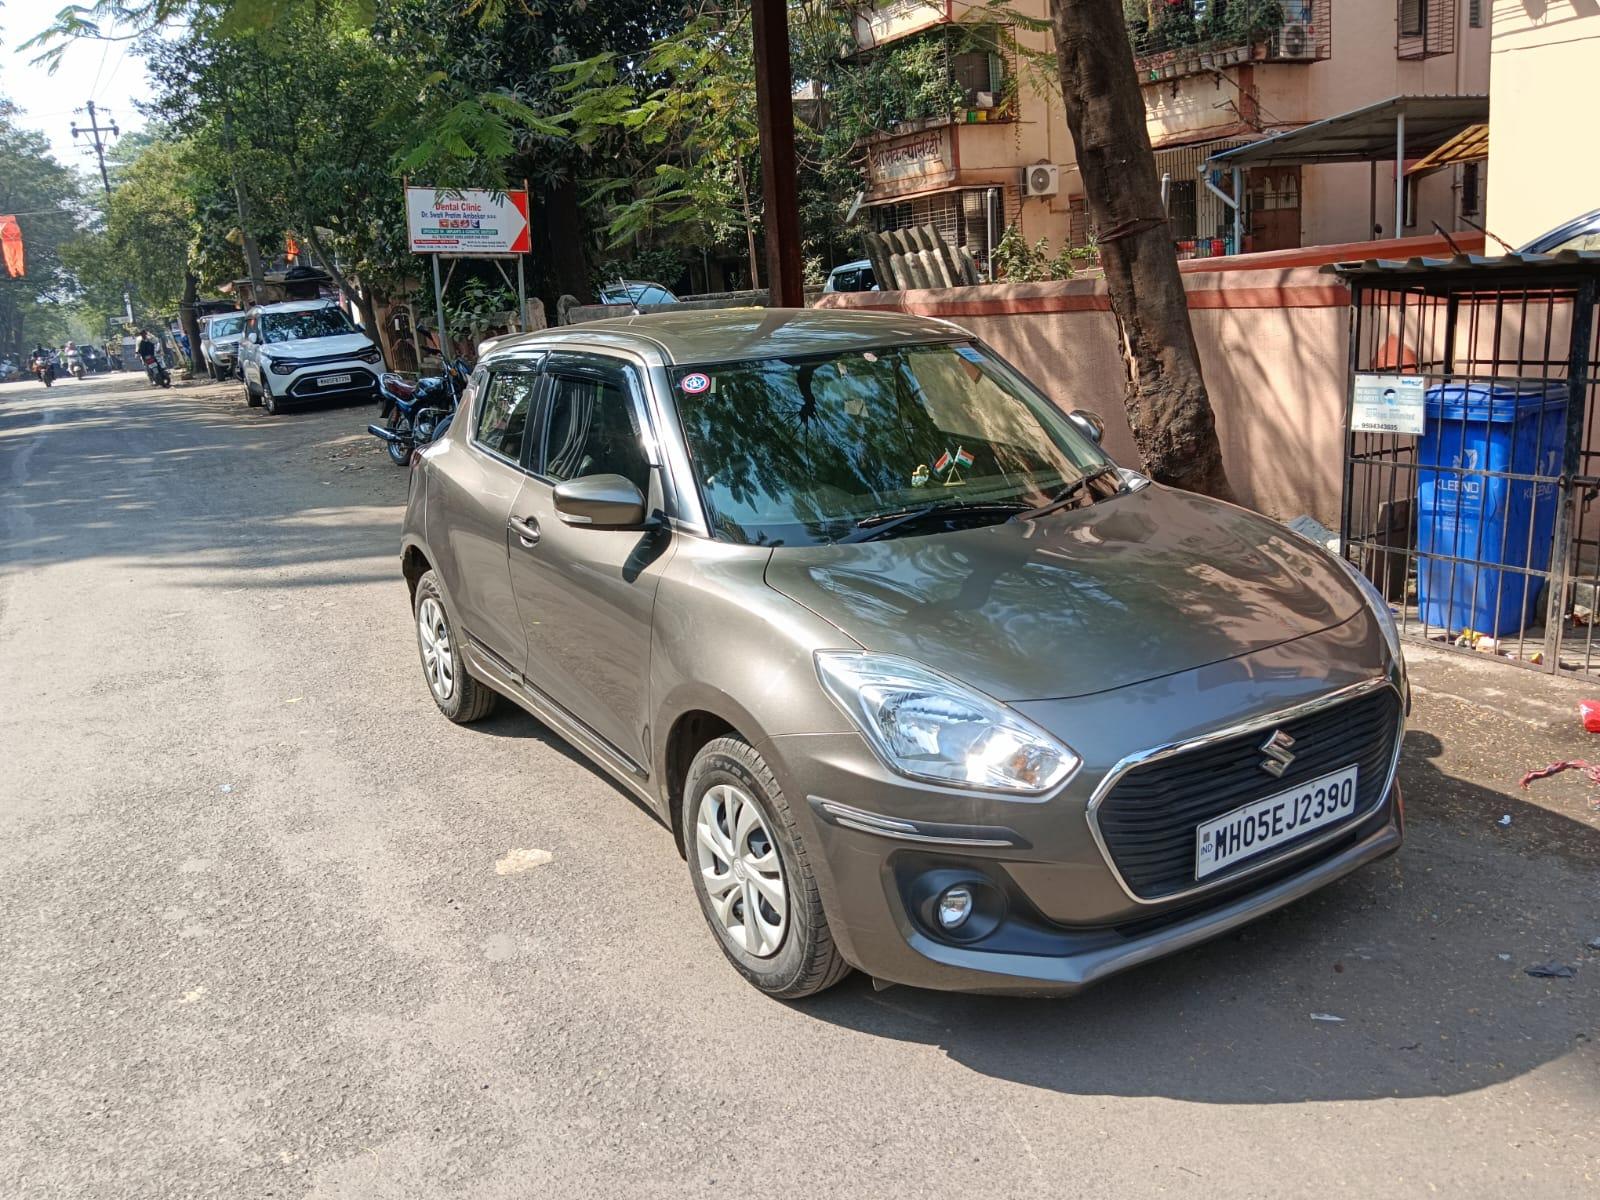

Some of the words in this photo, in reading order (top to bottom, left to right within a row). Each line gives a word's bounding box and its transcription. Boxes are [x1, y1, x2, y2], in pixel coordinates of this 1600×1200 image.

[435, 202, 459, 211] Dental
[461, 202, 482, 212] Clinic
[1214, 777, 1353, 862] MH05EJ2390
[1200, 843, 1213, 856] IND
